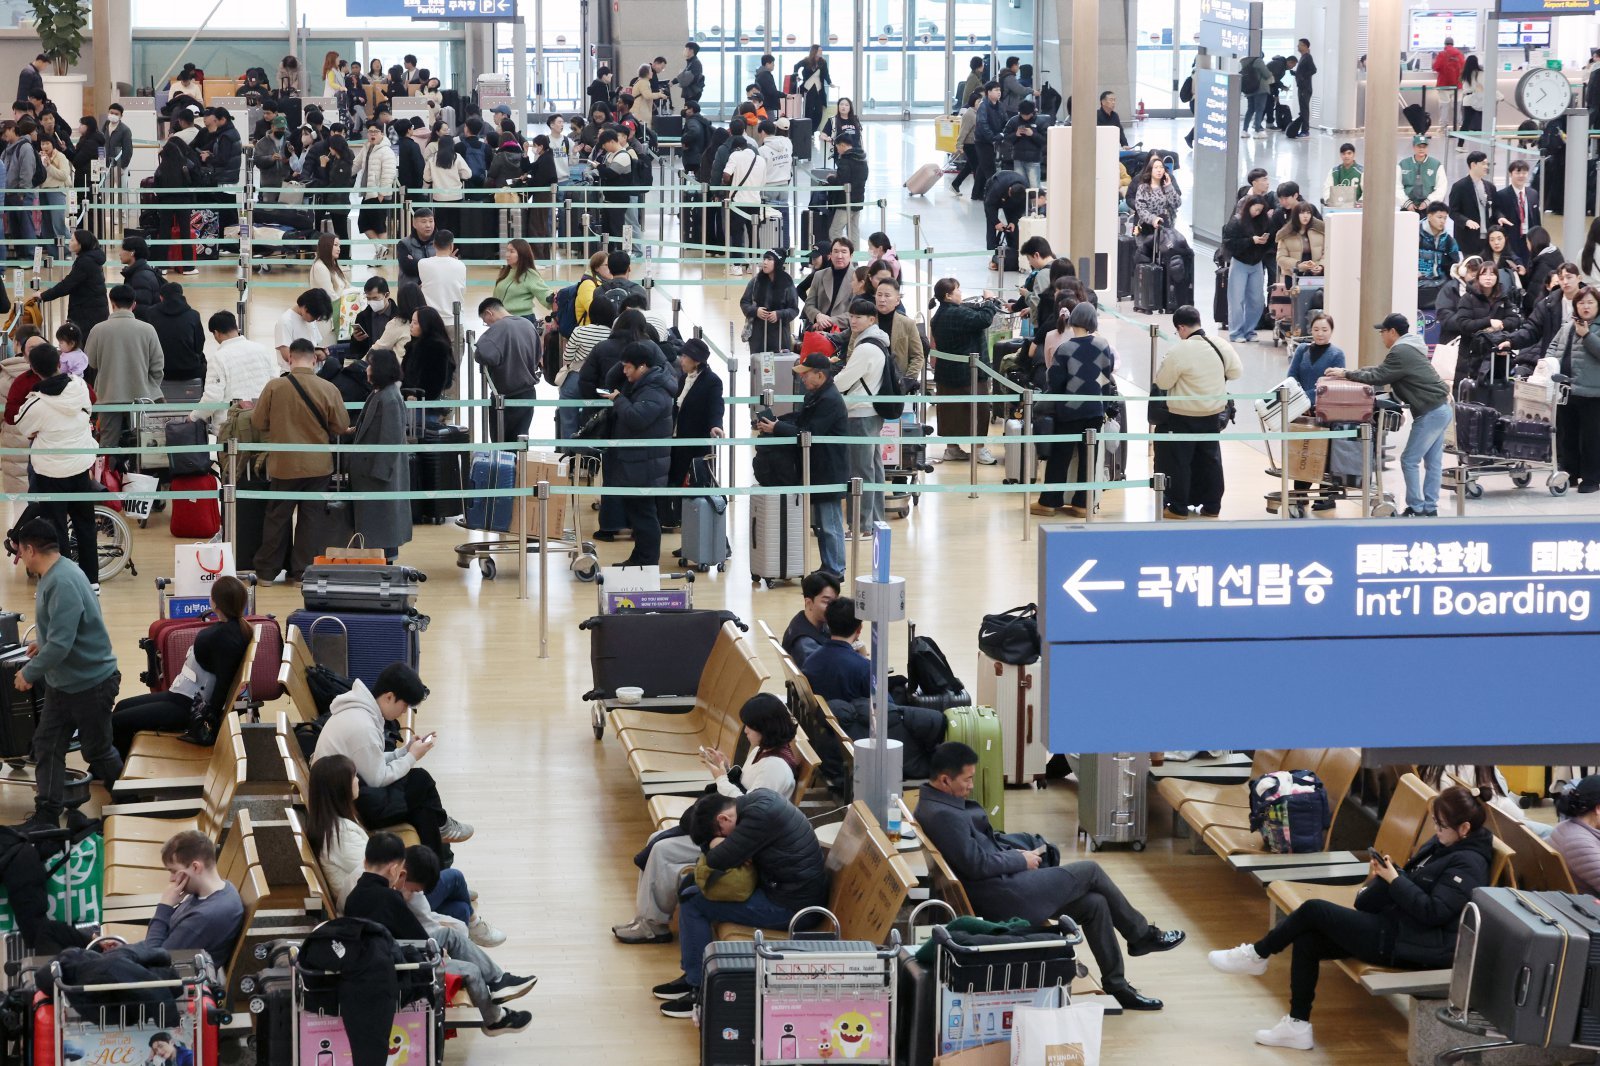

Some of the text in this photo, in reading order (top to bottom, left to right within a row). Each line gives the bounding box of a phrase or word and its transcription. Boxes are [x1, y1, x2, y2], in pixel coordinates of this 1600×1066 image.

[418, 6, 445, 15] Parking
[449, 0, 476, 11] 주차장
[1357, 541, 1492, 574] 国际线登机
[1137, 561, 1333, 608] 국제선탑승
[1434, 580, 1590, 621] Boarding
[184, 603, 211, 614] 어부어
[1048, 1054, 1078, 1062] HYUNDAI
